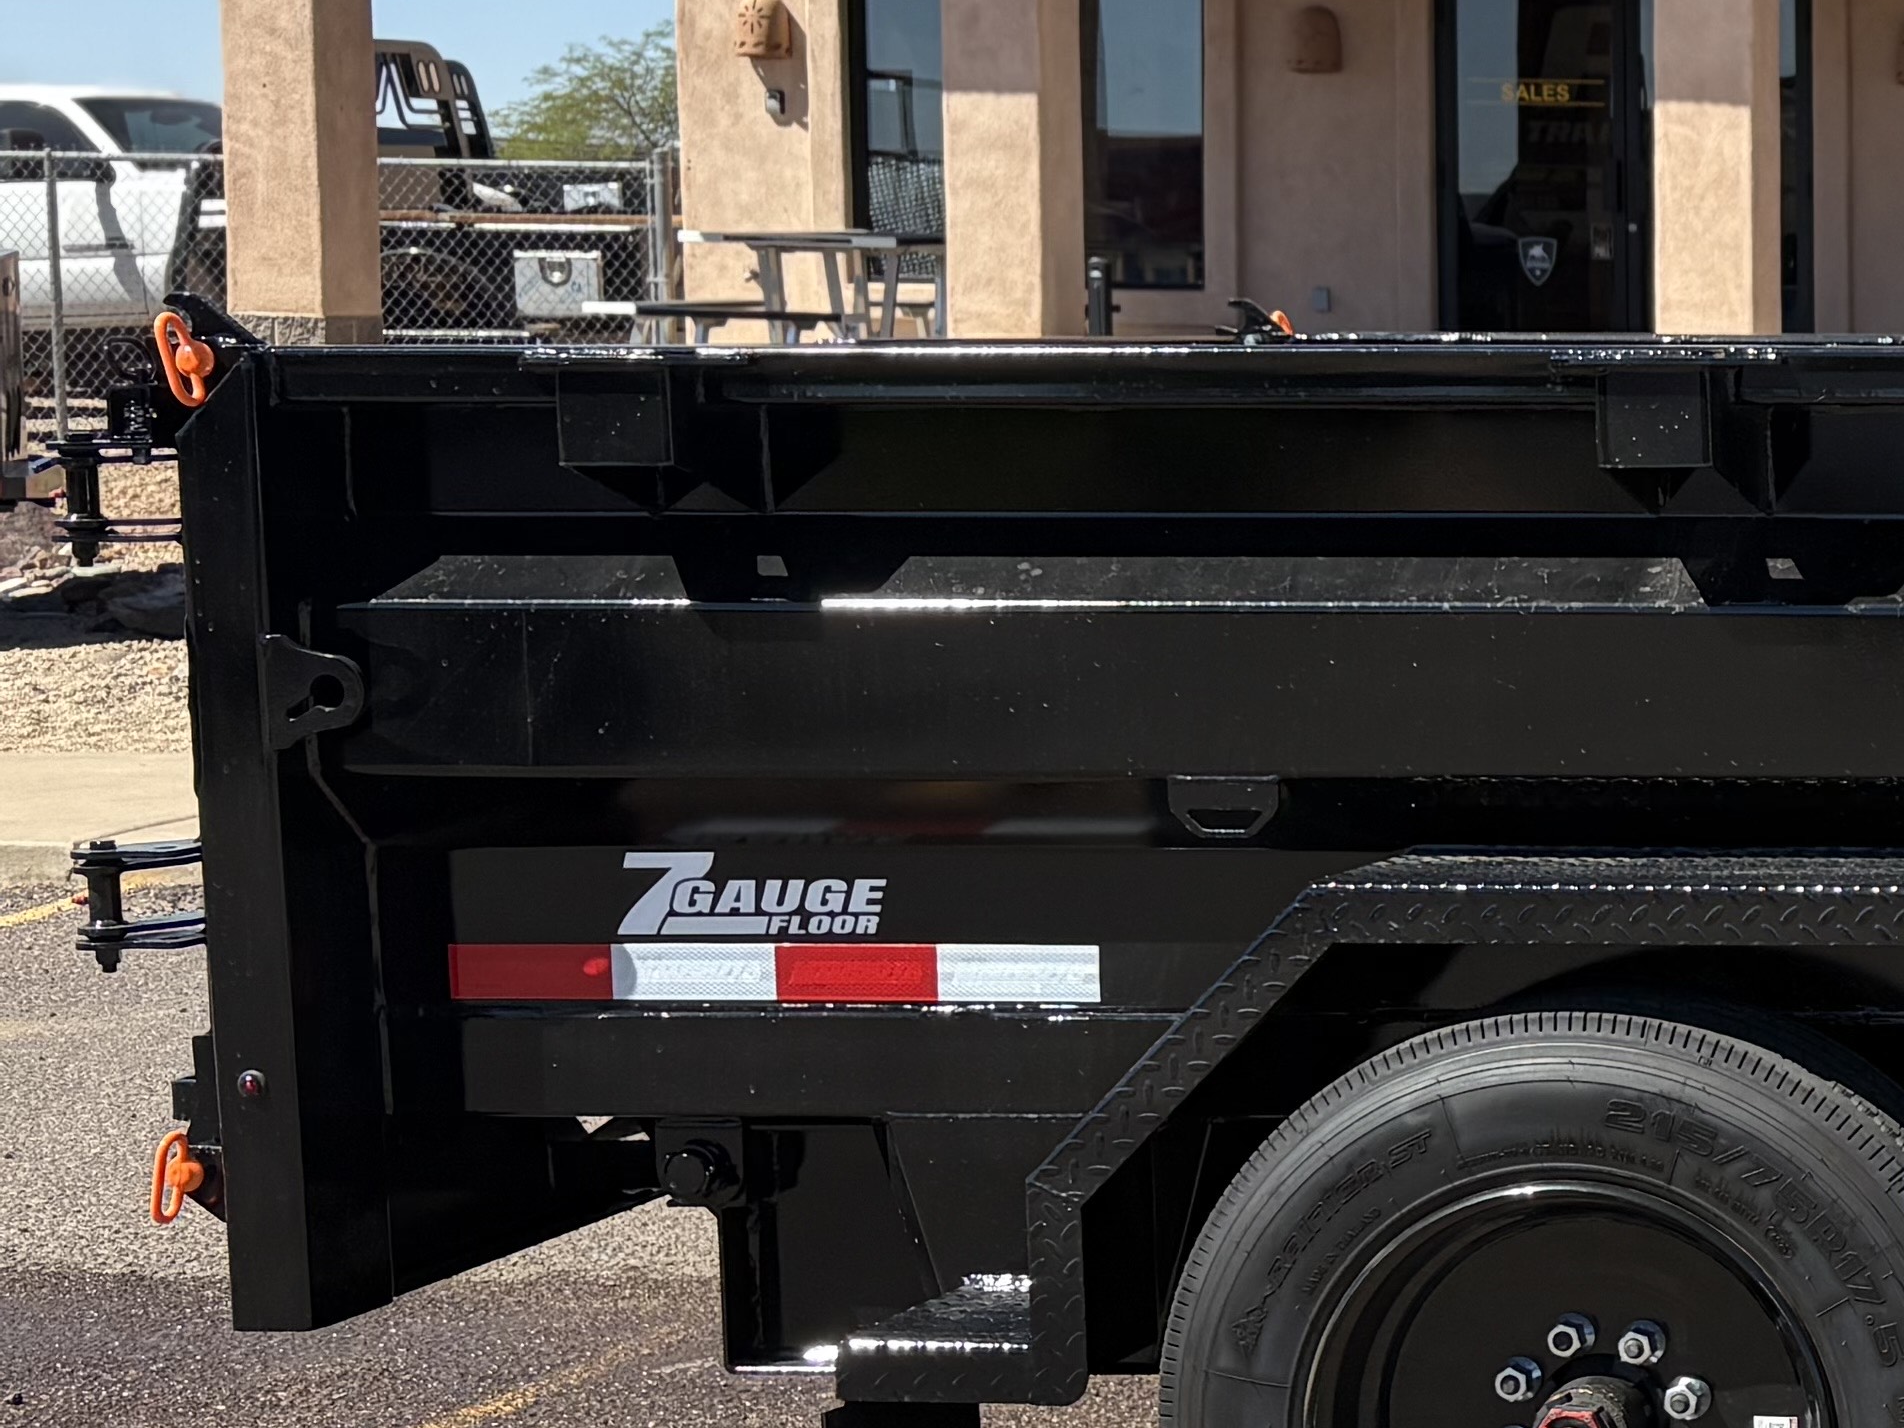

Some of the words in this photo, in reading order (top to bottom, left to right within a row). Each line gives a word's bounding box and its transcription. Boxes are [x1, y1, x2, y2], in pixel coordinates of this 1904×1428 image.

[1501, 83, 1570, 102] SALES
[617, 851, 715, 936] 7
[672, 878, 888, 915] GAUGE
[767, 914, 880, 936] FLOOR
